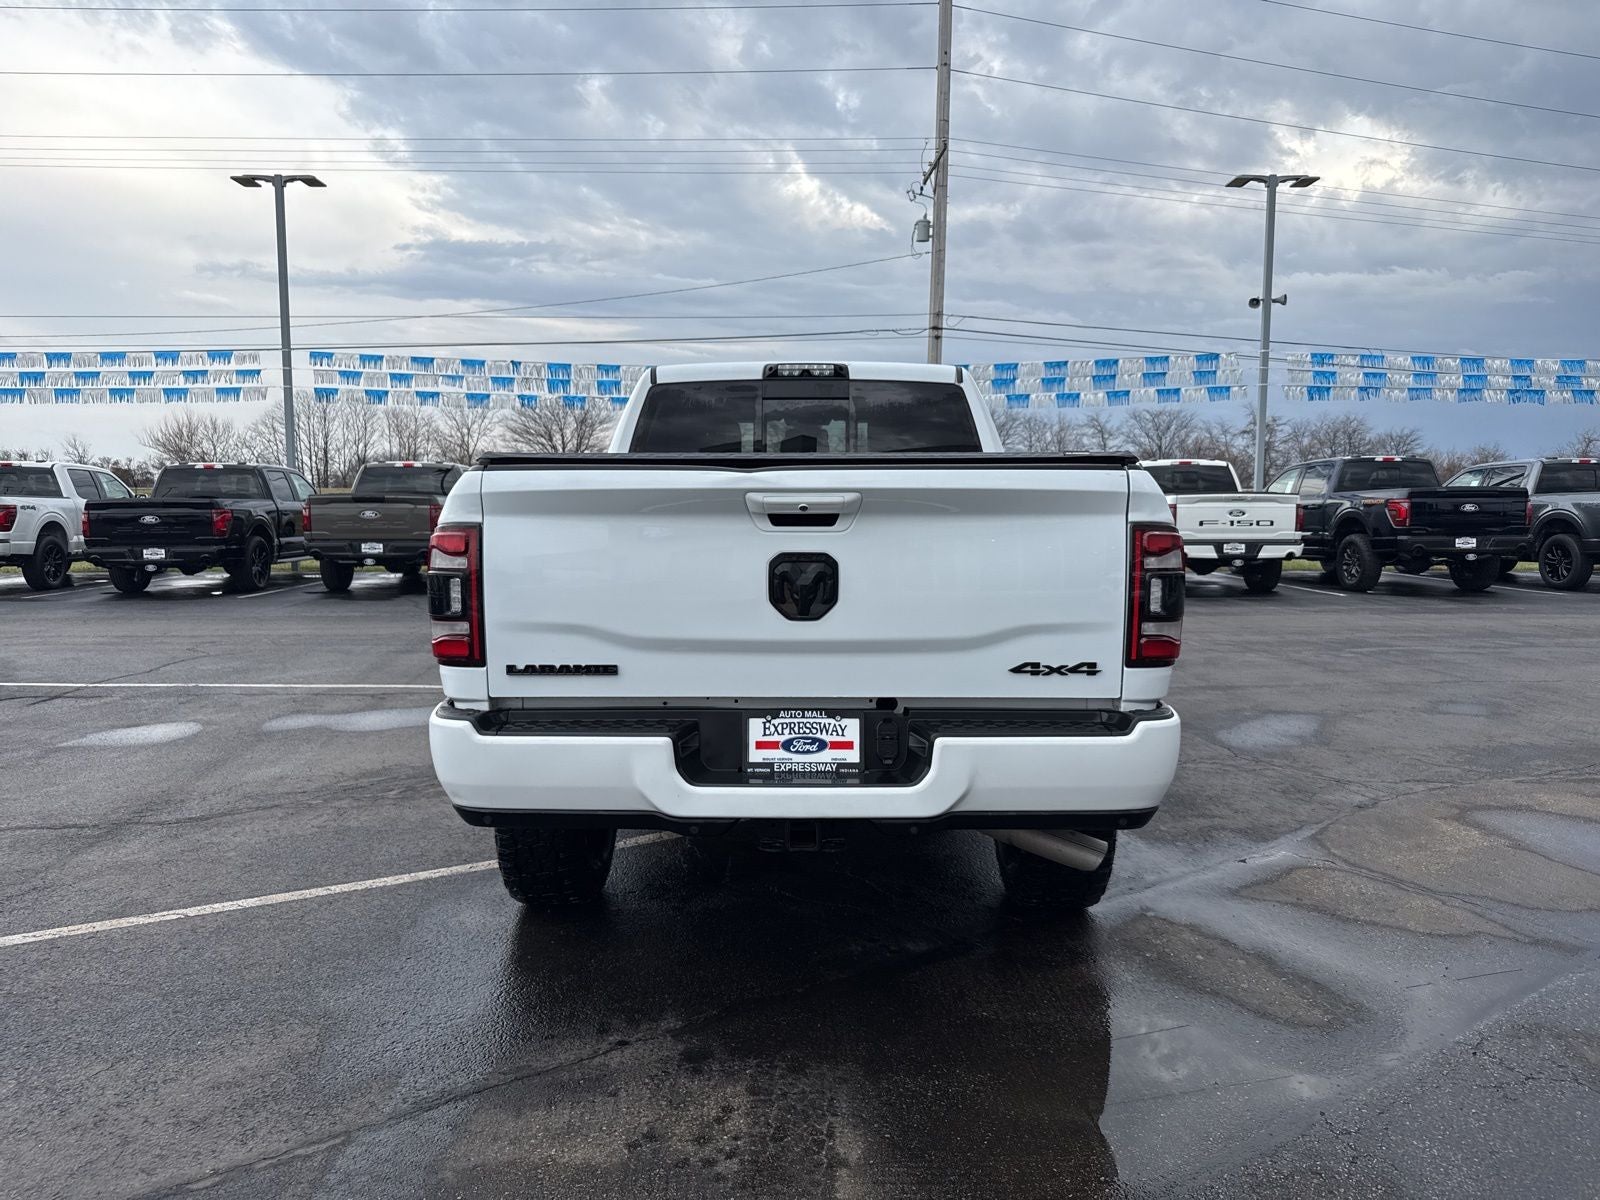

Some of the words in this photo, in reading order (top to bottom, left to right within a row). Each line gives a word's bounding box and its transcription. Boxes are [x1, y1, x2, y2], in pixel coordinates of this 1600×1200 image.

[506, 664, 619, 676] LARAMIE
[779, 710, 802, 718] AUTO
[805, 710, 827, 718] MALL
[790, 739, 819, 752] Ford
[774, 763, 837, 772] EXPRESSWAY
